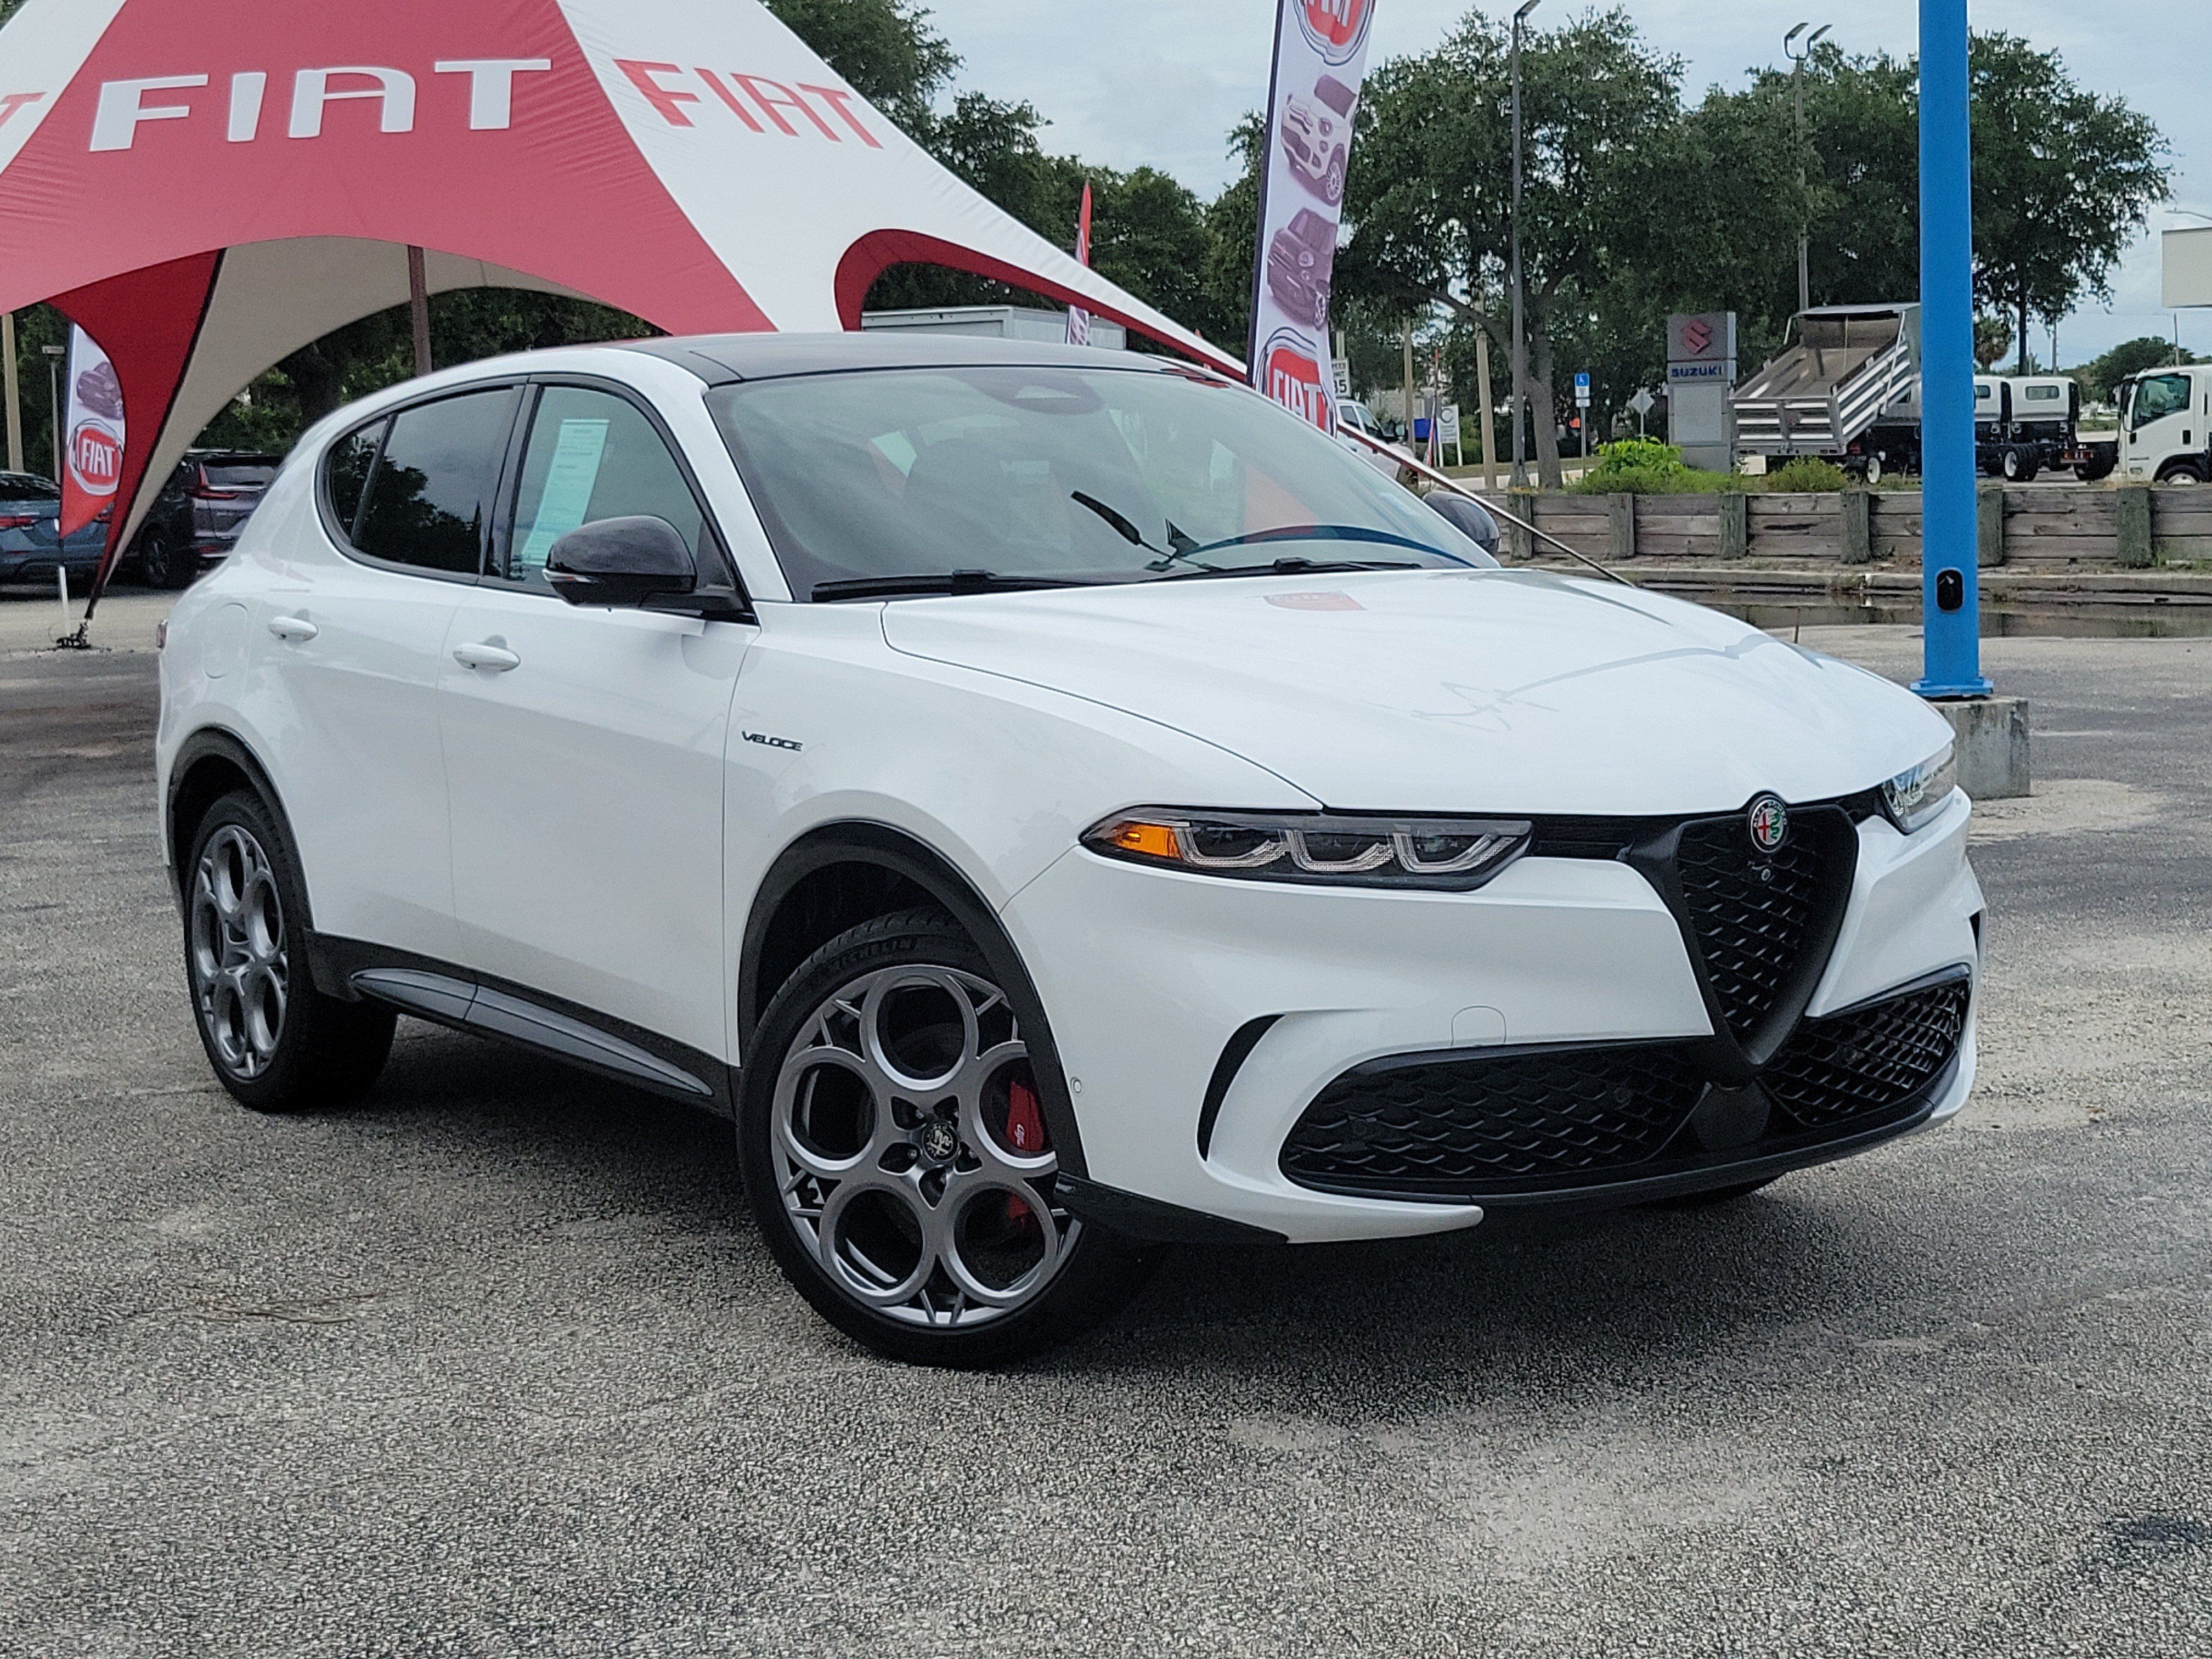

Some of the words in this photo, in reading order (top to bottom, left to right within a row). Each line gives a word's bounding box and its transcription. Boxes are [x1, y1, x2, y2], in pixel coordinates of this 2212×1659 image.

[89, 59, 551, 151] FIAT
[613, 59, 884, 149] FIAT
[1672, 366, 1722, 377] SUZUKI
[81, 438, 115, 477] FIAT
[742, 731, 803, 752] VELOCE
